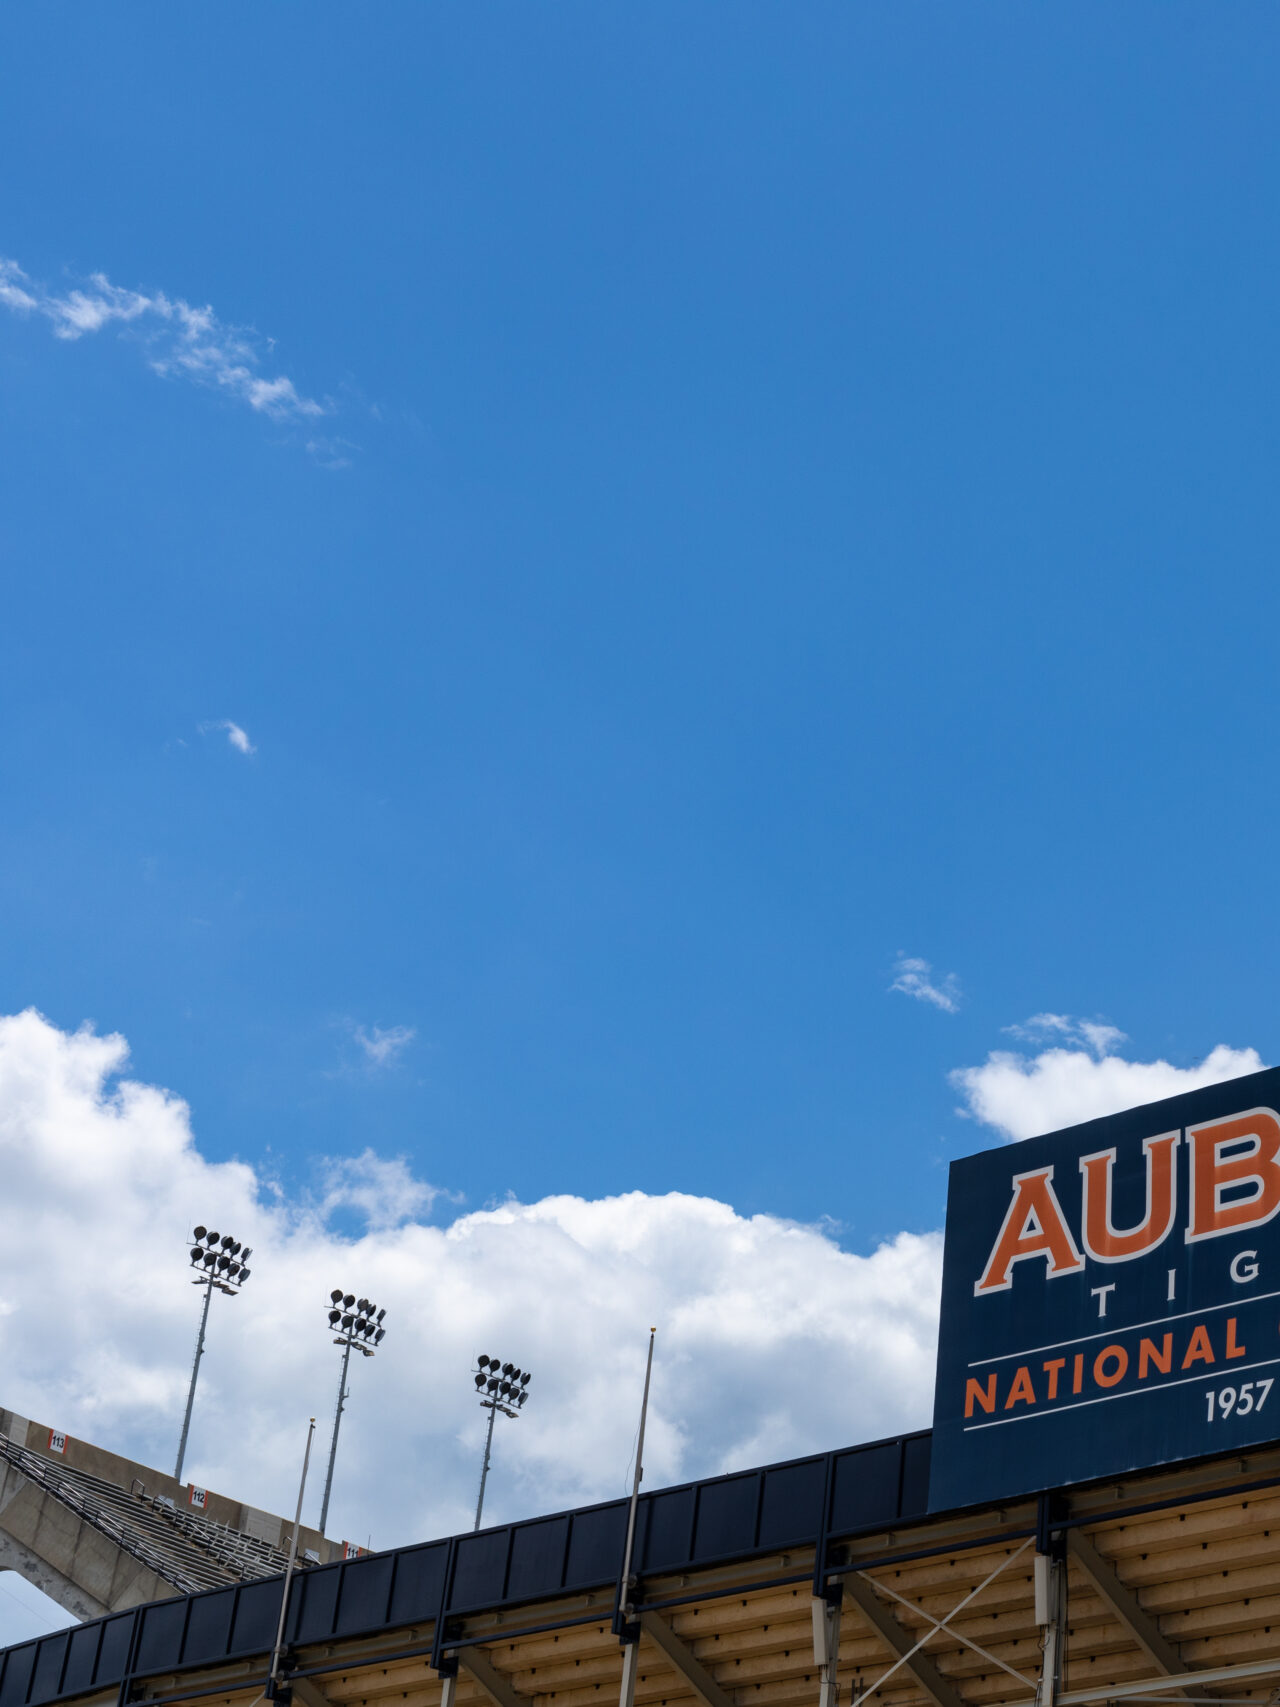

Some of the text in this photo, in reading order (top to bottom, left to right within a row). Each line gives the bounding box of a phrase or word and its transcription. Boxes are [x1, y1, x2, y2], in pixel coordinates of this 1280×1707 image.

[963, 1317, 1247, 1419] NATIONAL
[1205, 1378, 1275, 1423] 1957
[52, 1435, 65, 1449] 113
[193, 1490, 205, 1503] 112
